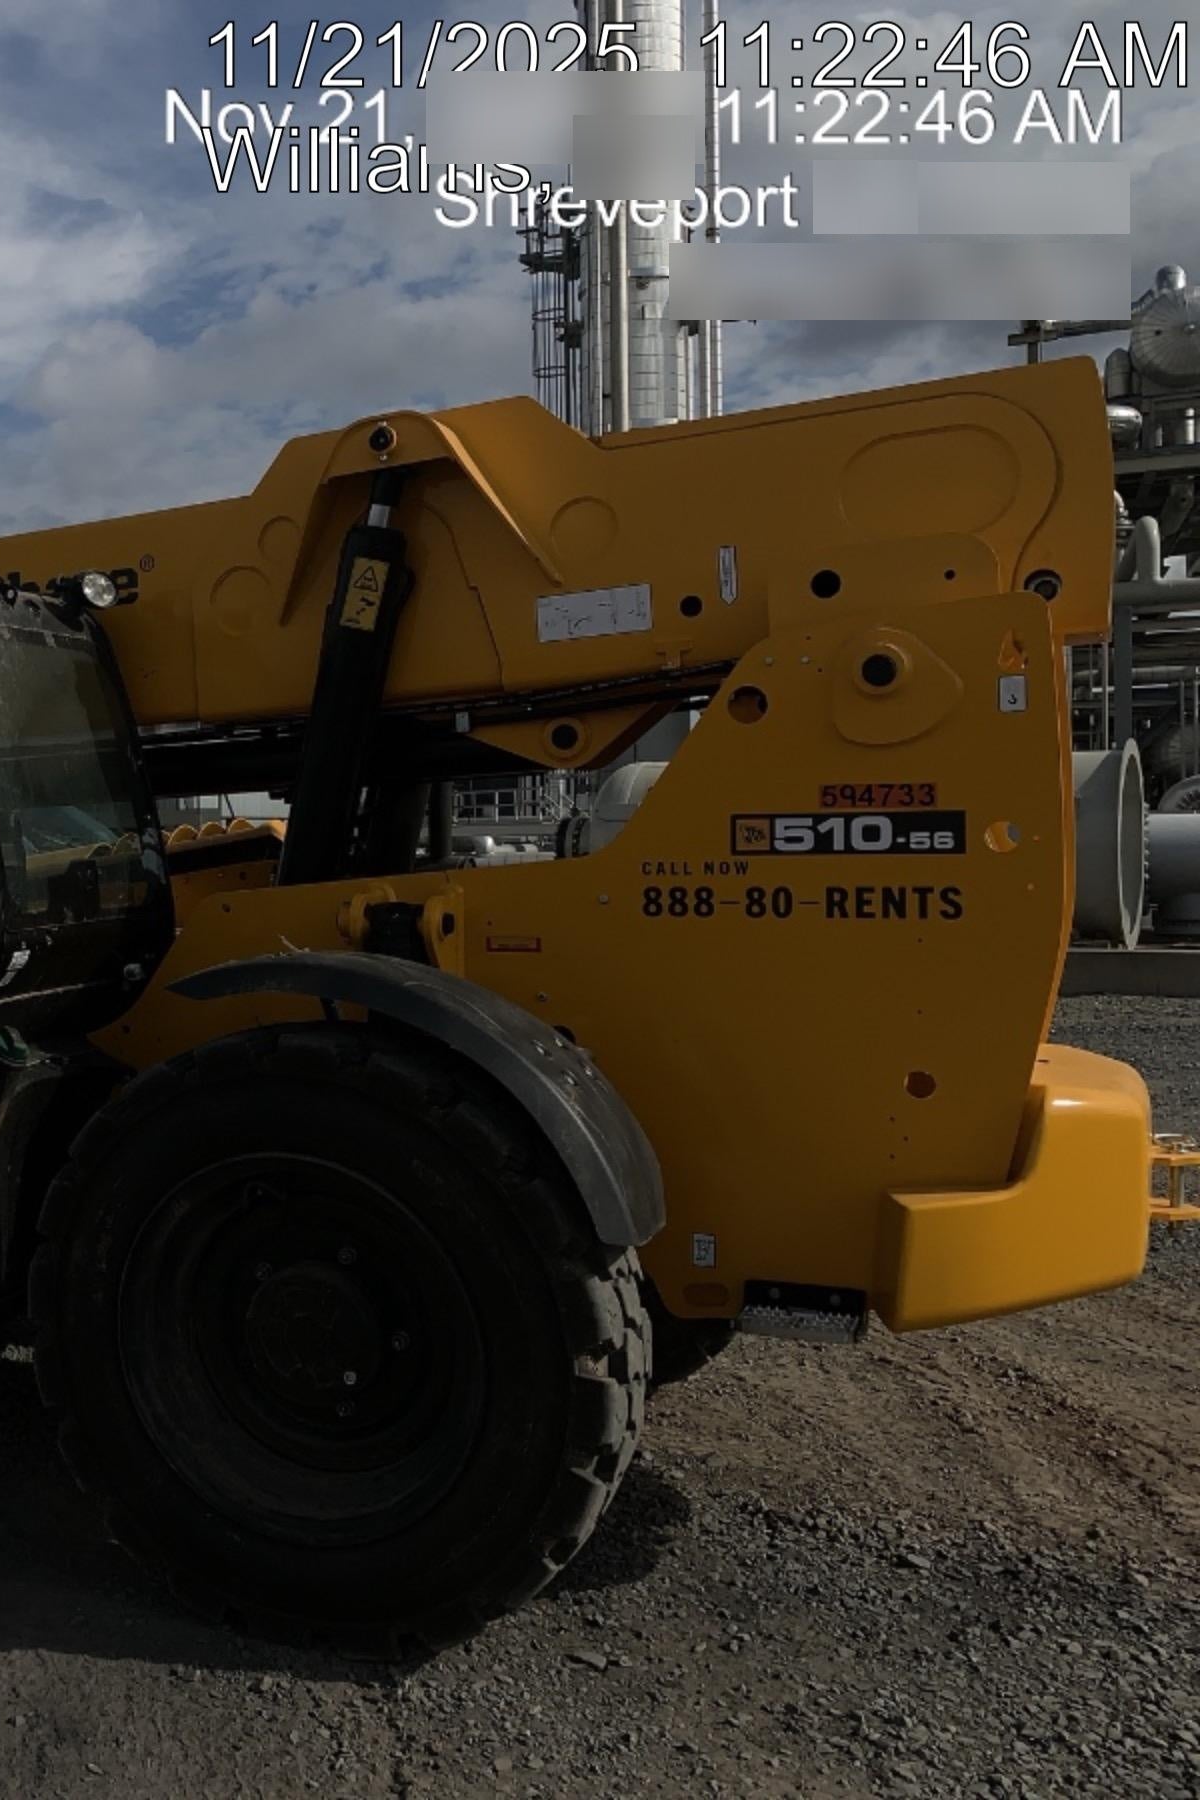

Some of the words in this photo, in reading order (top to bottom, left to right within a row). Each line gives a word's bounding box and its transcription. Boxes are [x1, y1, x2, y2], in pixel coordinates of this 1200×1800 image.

[821, 782, 937, 808] 594733
[641, 861, 693, 876] CALL
[703, 860, 750, 876] NOW
[641, 885, 964, 920] 888-80-RENTS
